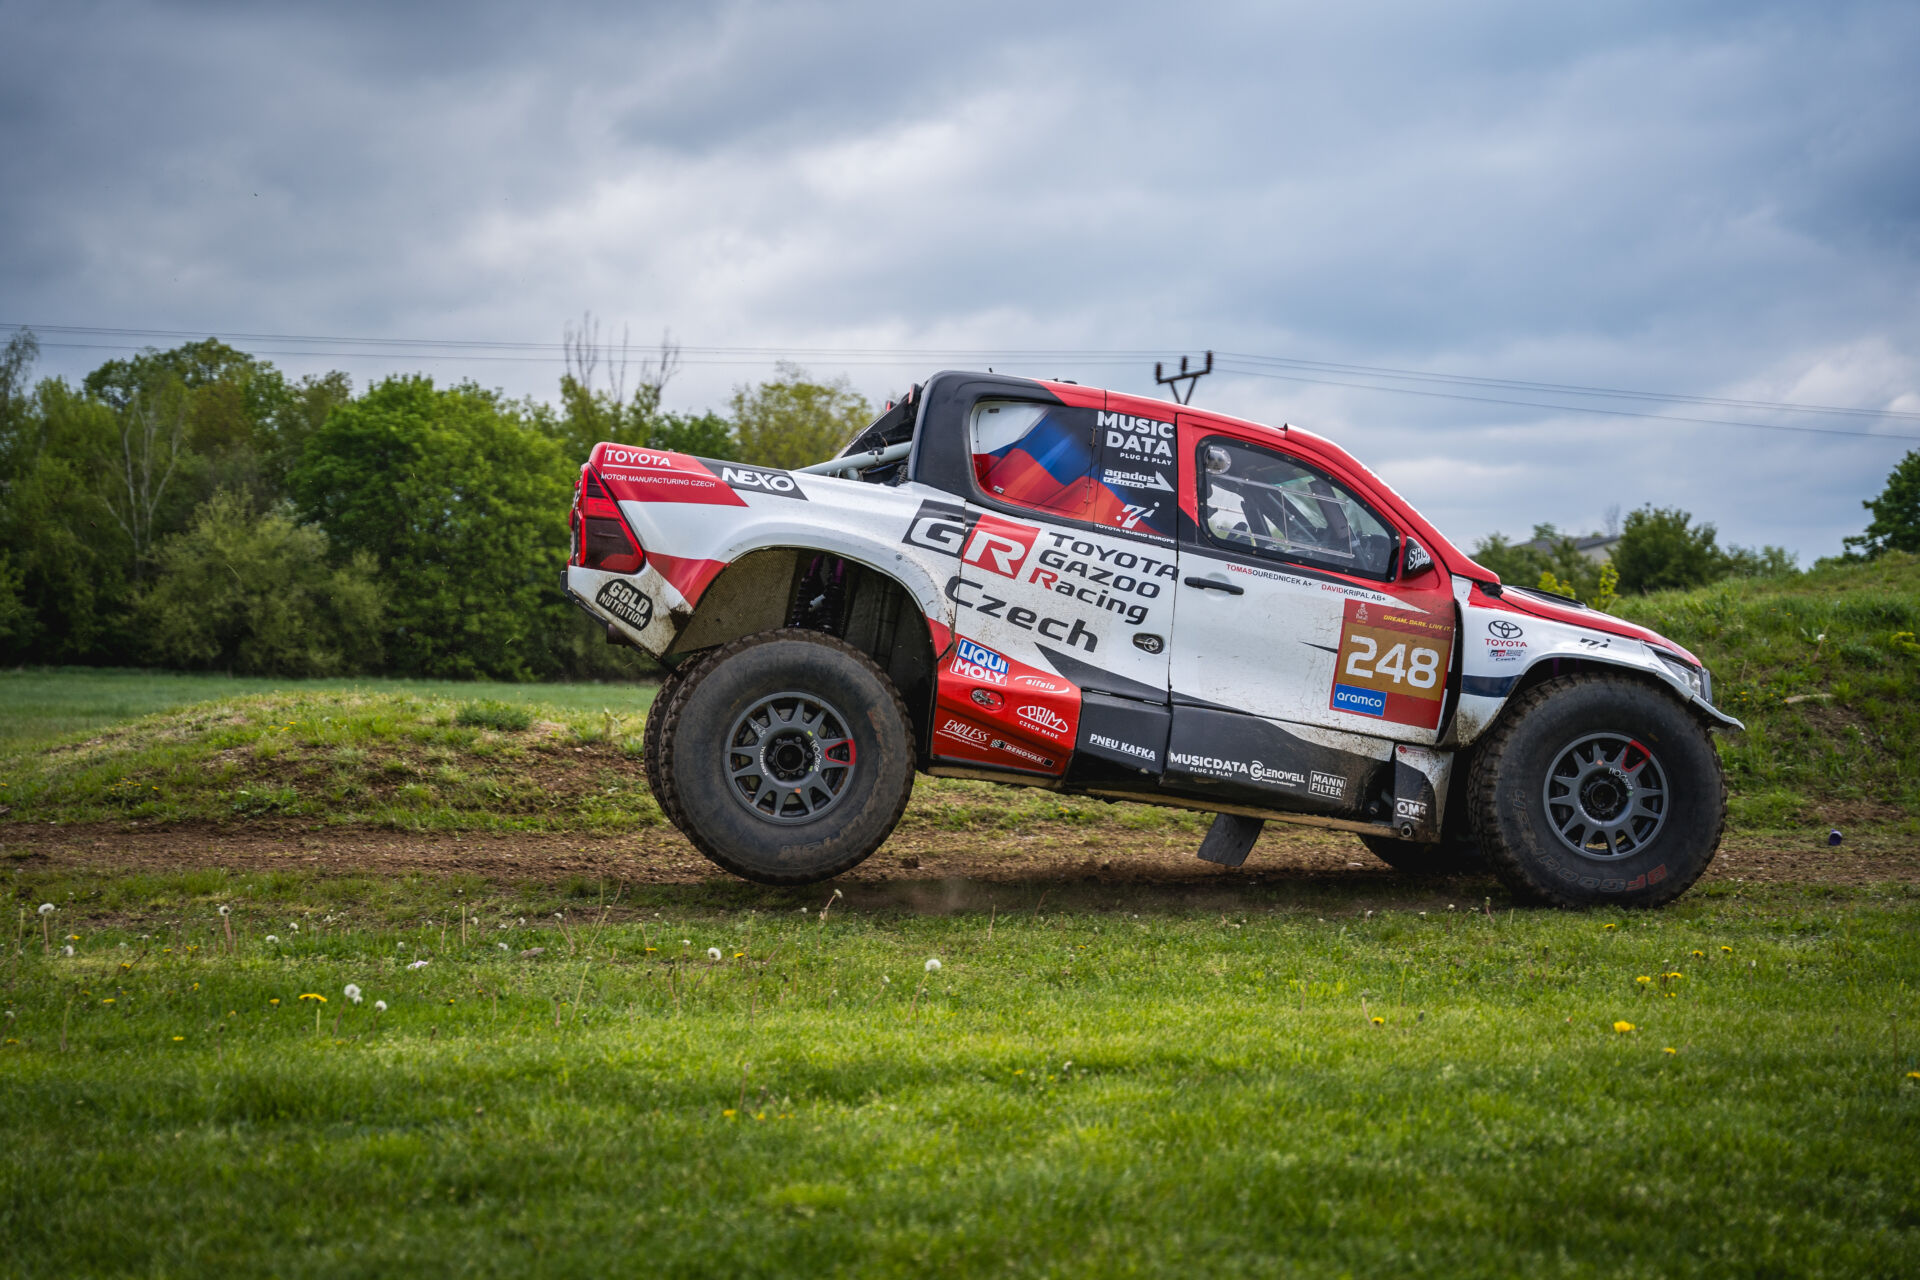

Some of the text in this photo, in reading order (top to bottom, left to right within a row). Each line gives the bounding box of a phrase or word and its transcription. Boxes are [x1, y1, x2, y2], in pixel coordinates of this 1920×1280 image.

[1097, 411, 1174, 438] MUSIC
[1106, 431, 1172, 457] DATA
[606, 450, 671, 467] TOYOTA
[1120, 452, 1140, 461] PLUG
[1152, 457, 1172, 466] PLAY
[601, 472, 716, 488] MOTOR MANUFACTURING CZECH
[722, 467, 795, 492] NEXO
[1104, 468, 1155, 483] agados
[1095, 523, 1175, 544] TOYOTA TSUSHO EUROPE
[908, 515, 1028, 578] GR
[1049, 532, 1179, 581] TOYOTA
[1038, 549, 1160, 599] GAZOO
[1302, 579, 1312, 587] A+
[608, 581, 650, 615] GOLD
[1028, 567, 1149, 626] Racing
[1371, 593, 1386, 601] AB+
[599, 592, 647, 627] NUTRITION
[945, 575, 1098, 653] Czech
[1485, 638, 1528, 648] TOYOTA
[959, 642, 1007, 672] LIQUI
[1345, 634, 1440, 689] 248
[954, 659, 1006, 684] MOLY
[1336, 691, 1382, 708] aramco
[1026, 705, 1064, 729] PRIM
[943, 719, 991, 742] ENDLESS
[1019, 720, 1060, 740] CZECH MADE
[1005, 745, 1043, 763] RENOVAK
[1089, 733, 1156, 760] PNEU KAFKA
[1170, 752, 1249, 774] MUSICDATA
[1190, 766, 1207, 774] PLUG
[1216, 770, 1233, 778] PLAY
[1311, 782, 1342, 797] FILTER
[1312, 773, 1344, 788] MANN
